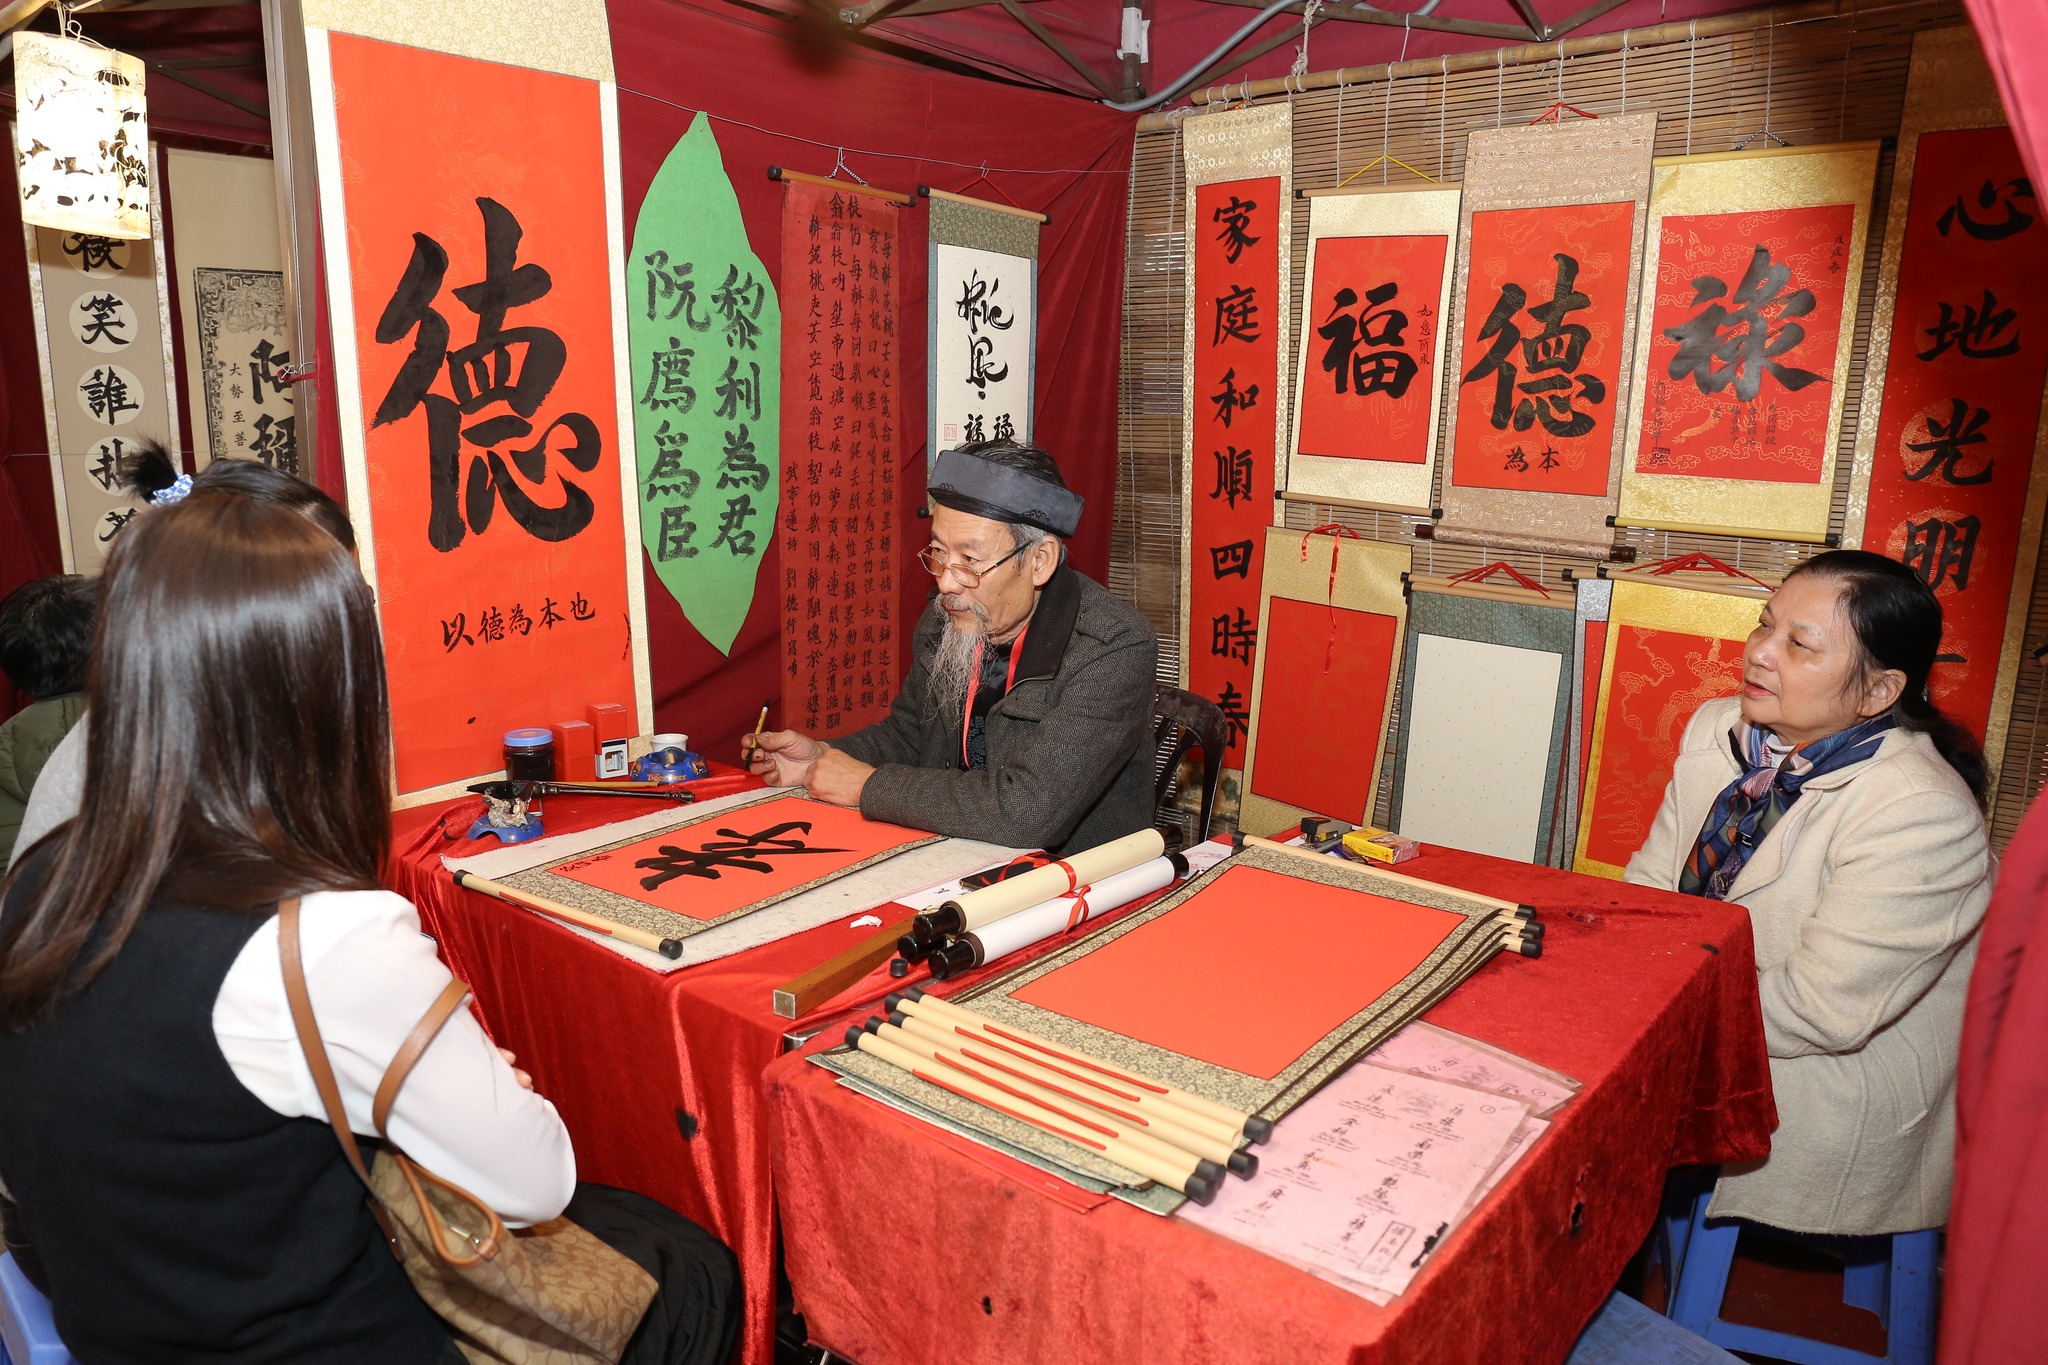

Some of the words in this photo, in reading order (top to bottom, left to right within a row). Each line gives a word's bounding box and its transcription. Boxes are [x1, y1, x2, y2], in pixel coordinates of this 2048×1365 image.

[371, 196, 602, 553] 德
[1317, 281, 1419, 399] 福
[1459, 252, 1607, 438] 德
[440, 591, 597, 654] 以德為本也
[634, 821, 860, 891] 孝
